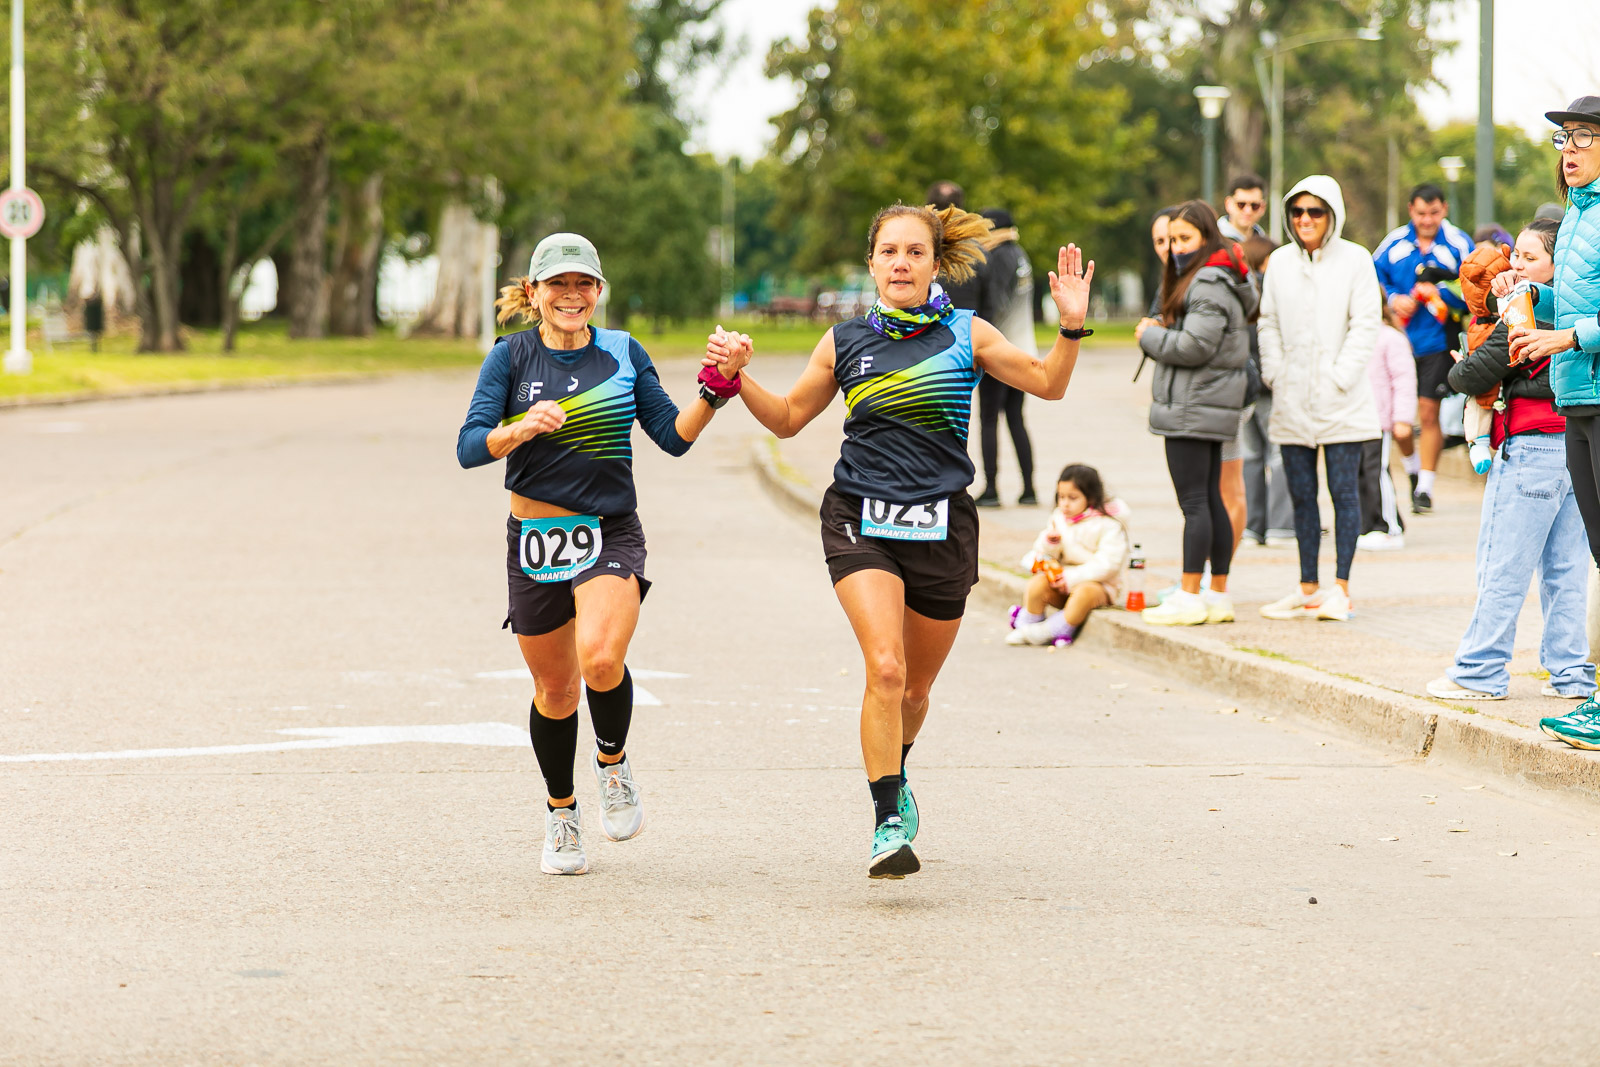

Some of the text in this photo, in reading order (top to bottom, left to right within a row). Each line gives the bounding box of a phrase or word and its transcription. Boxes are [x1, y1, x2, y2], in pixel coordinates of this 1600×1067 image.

[850, 355, 874, 377] SF
[517, 381, 544, 402] SF
[865, 526, 942, 540] DIAMANTE CORRE
[524, 523, 595, 571] 029
